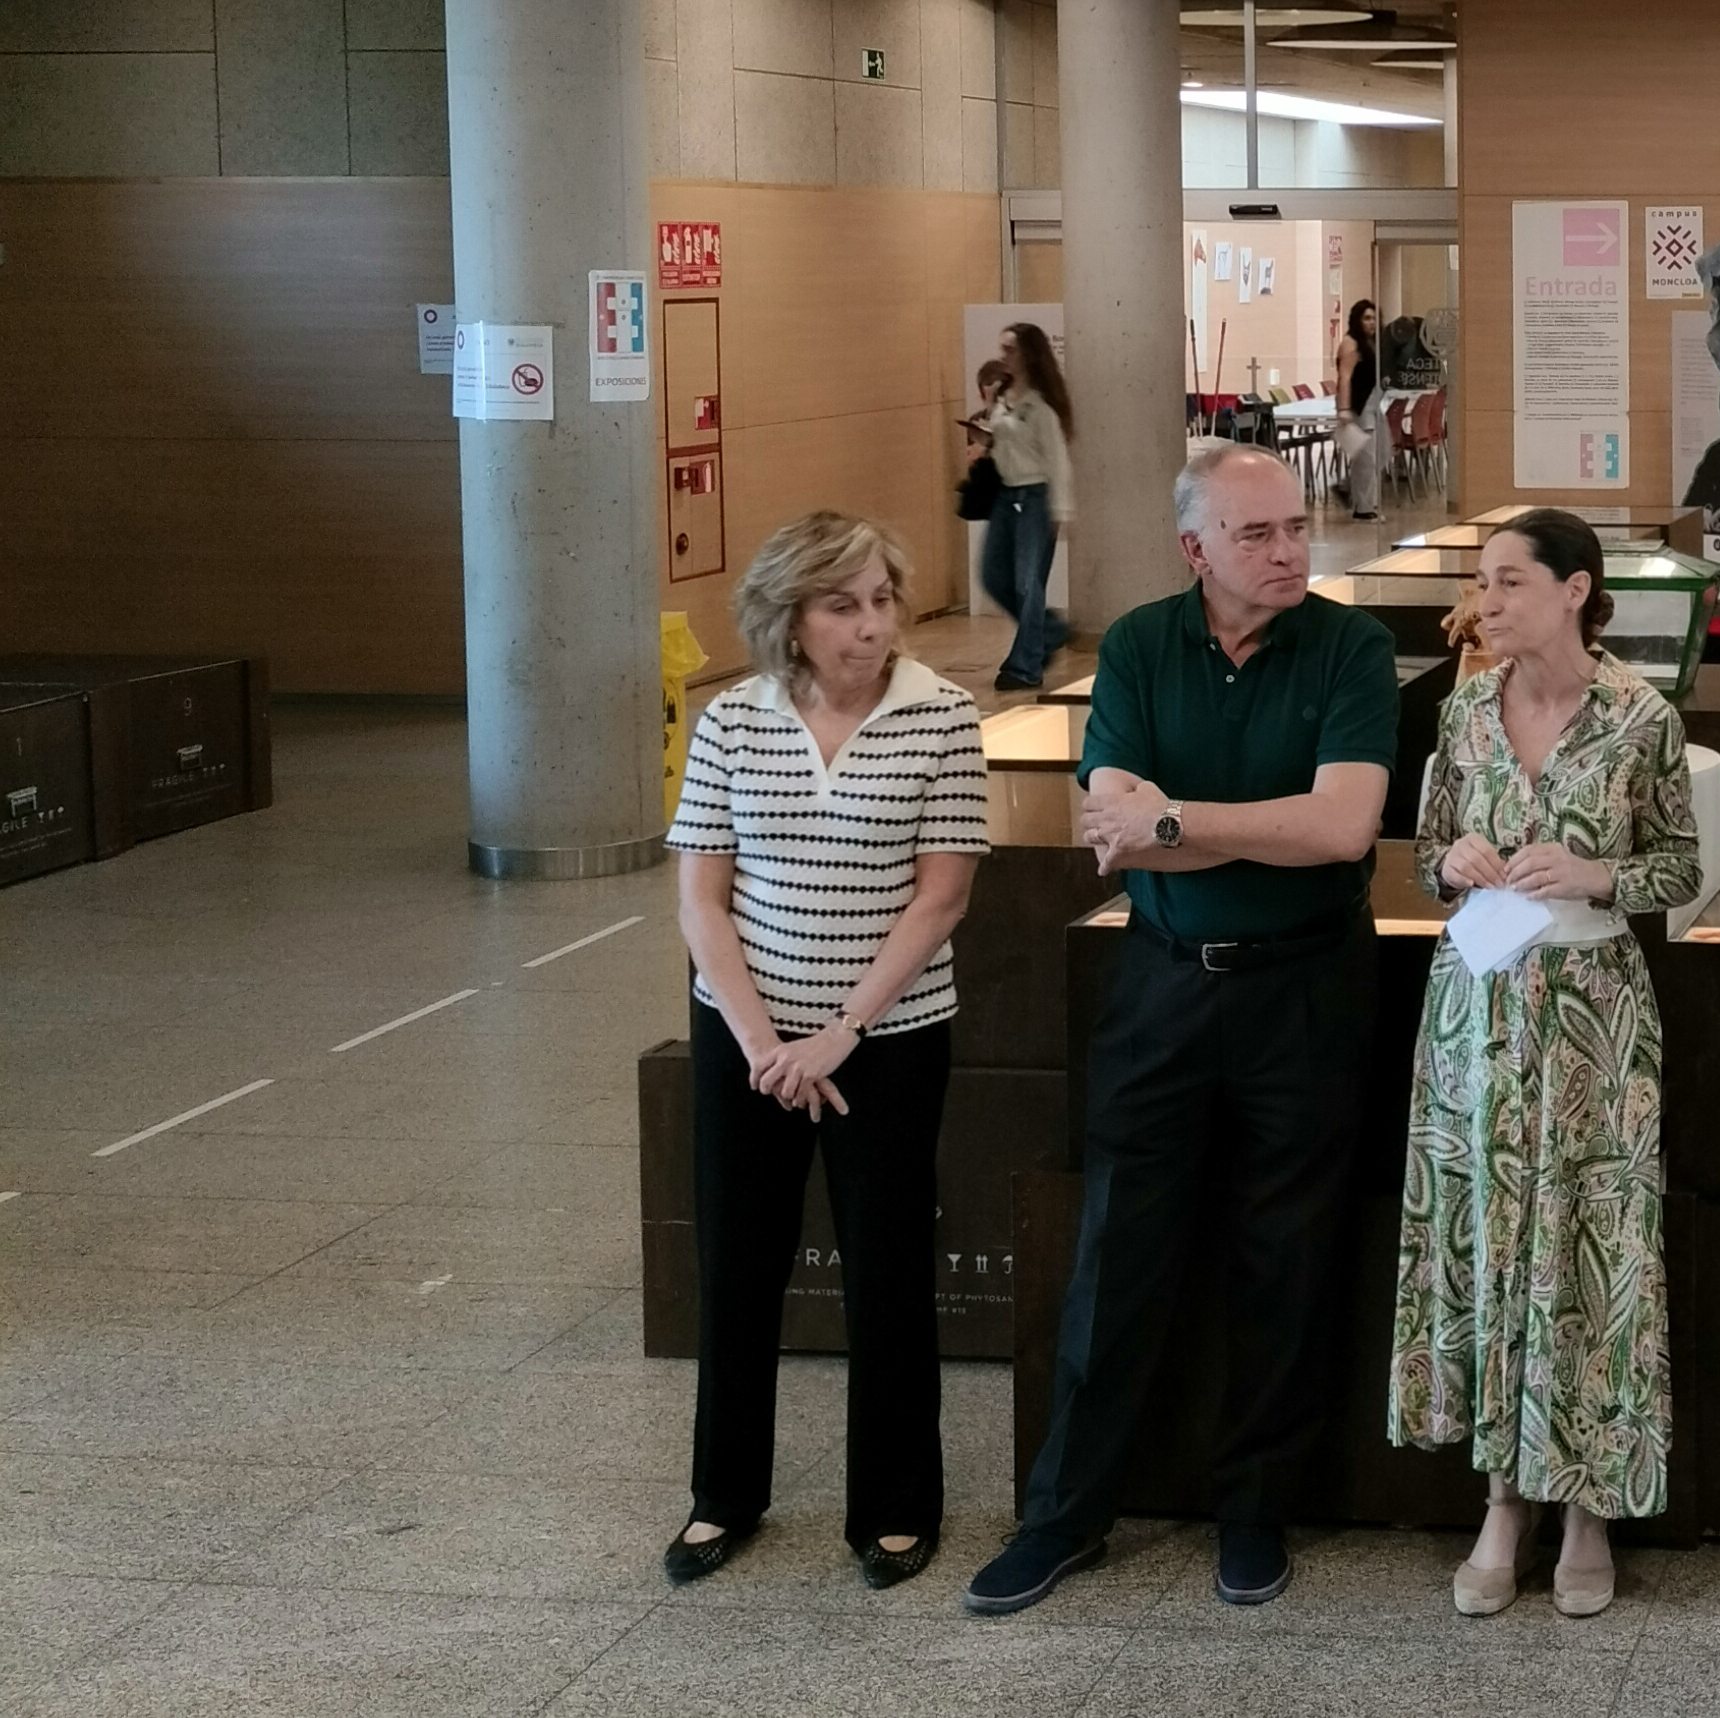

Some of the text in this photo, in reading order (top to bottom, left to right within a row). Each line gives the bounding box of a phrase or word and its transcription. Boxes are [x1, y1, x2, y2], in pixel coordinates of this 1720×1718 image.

[1651, 210, 1697, 218] campus
[1525, 275, 1617, 296] Entrada
[1652, 278, 1698, 286] MONCLOA
[0, 816, 28, 834] GILE
